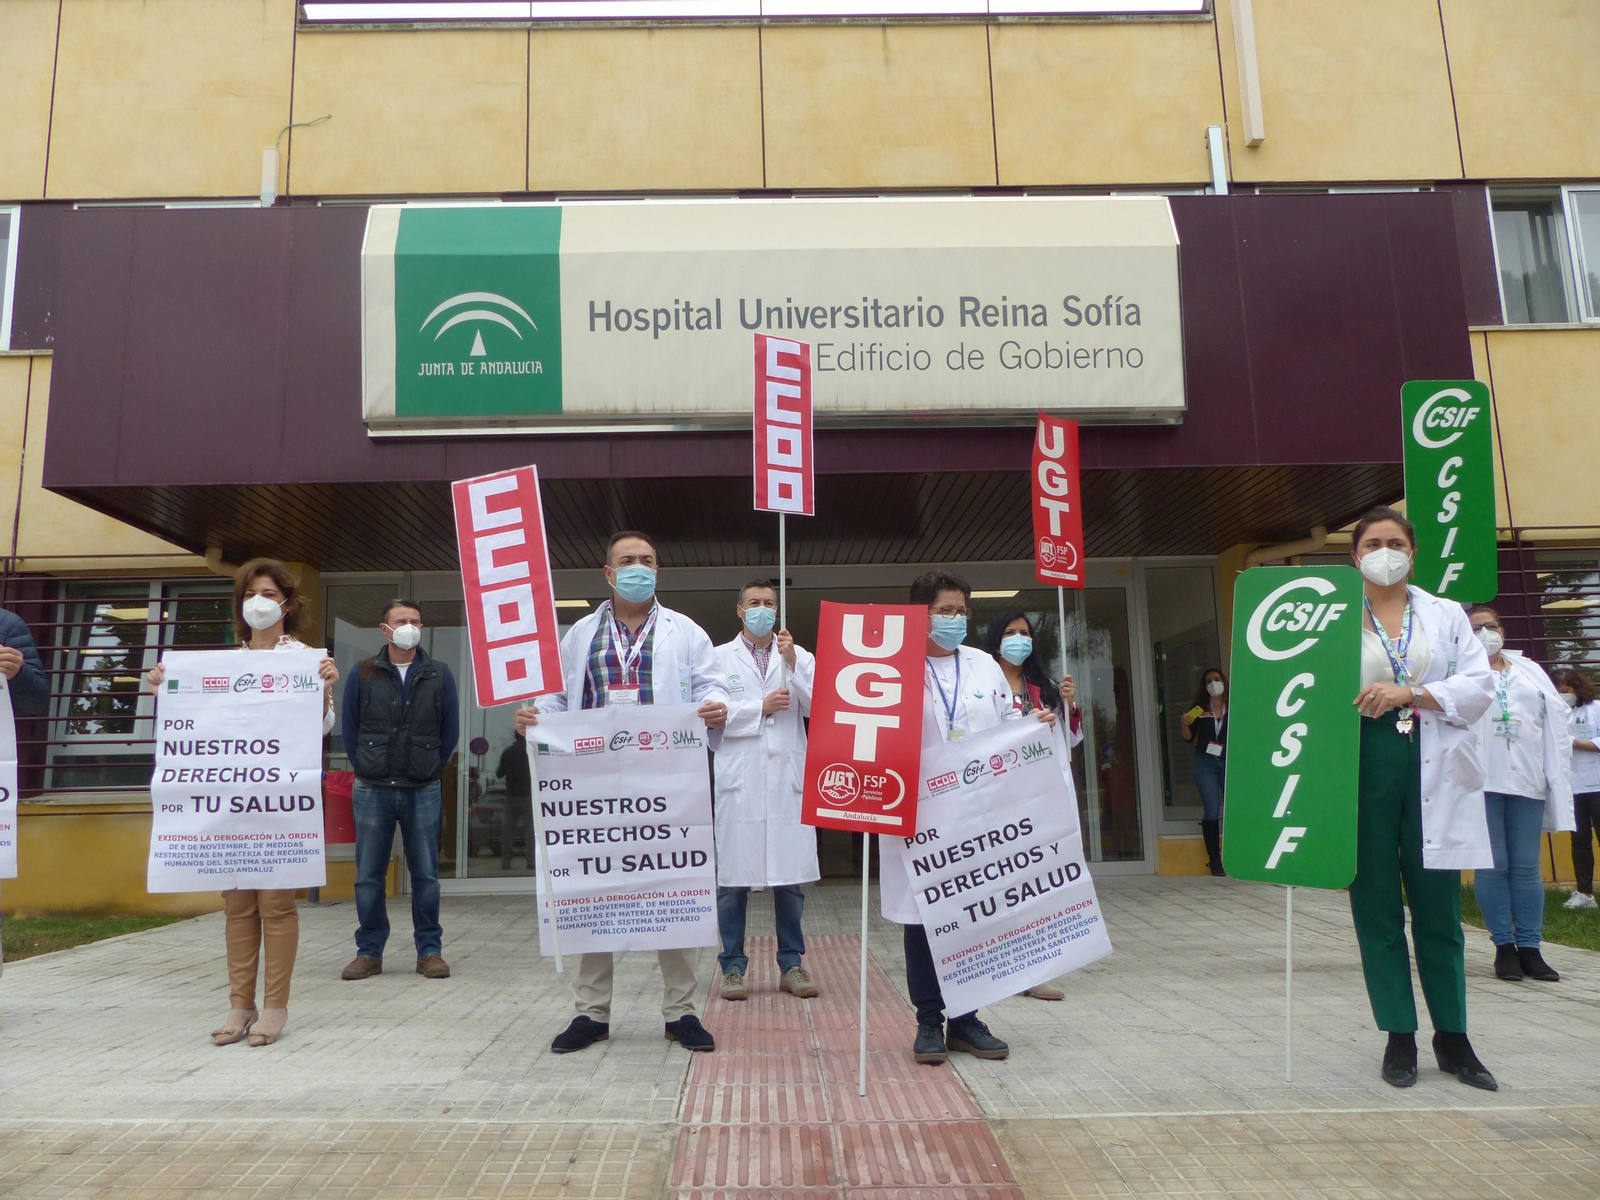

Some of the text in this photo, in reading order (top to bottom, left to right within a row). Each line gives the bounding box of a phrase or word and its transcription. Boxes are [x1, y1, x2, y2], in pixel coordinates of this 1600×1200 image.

[588, 294, 1142, 340] Hospital Universitario Reina Sofía
[816, 340, 1144, 372] Edificio de Gobierno
[418, 362, 454, 376] JUNTA
[460, 362, 474, 376] DE
[766, 337, 804, 512] CCOO
[1038, 419, 1070, 536] UGT
[1436, 456, 1465, 594] CSIF
[468, 474, 544, 700] CCOO
[204, 678, 228, 687] CCOO
[834, 614, 905, 762] UGT
[164, 719, 195, 730] POR
[163, 739, 280, 756] NUESTROS
[576, 738, 603, 749] CCOO
[161, 767, 298, 783] DERECHOS Y
[824, 770, 854, 789] UGT
[864, 775, 887, 788] FSP
[928, 773, 956, 789] CCOO
[1264, 672, 1315, 870] CSIF
[539, 779, 573, 791] POR
[162, 795, 315, 813] POR TU SALUD
[540, 796, 667, 817] NUESTROS
[214, 832, 272, 841] DEROGACIÓN
[545, 824, 689, 846] DERECHOS Y
[904, 828, 940, 849] POR
[912, 817, 1033, 876] NUESTROS
[578, 856, 611, 875] TU
[621, 850, 707, 872] SALUD
[924, 842, 1059, 904] DERECHOS Y
[593, 902, 643, 911] NOVIEMBRE,
[606, 891, 664, 902] DEROGACIÓN
[935, 862, 1081, 936] POR TU SALUD
[544, 912, 603, 924] RSTRICTIVAS
[619, 909, 655, 917] MATERIA
[670, 906, 712, 915] RECURSOS
[557, 922, 598, 931] HUMANOS
[655, 915, 700, 924] SANITARIO
[592, 927, 627, 935] PÚBLICO
[941, 899, 1093, 965] EXIGIMOS LA DEROGACIÓN LA ORDEN
[956, 960, 967, 968] DE
[975, 952, 985, 962] DE
[988, 934, 1034, 958] NOVIEMBRE,
[1036, 928, 1046, 936] DE
[1047, 913, 1082, 932] MEDIDAS
[943, 915, 1099, 982] RESTRICTIVAS EN MATERIA DE RECURSOS
[957, 928, 1090, 985] HUMANOS DEL SISTEMA SANITARIO
[992, 949, 1062, 981] PÚBLICO ANDALUZ
